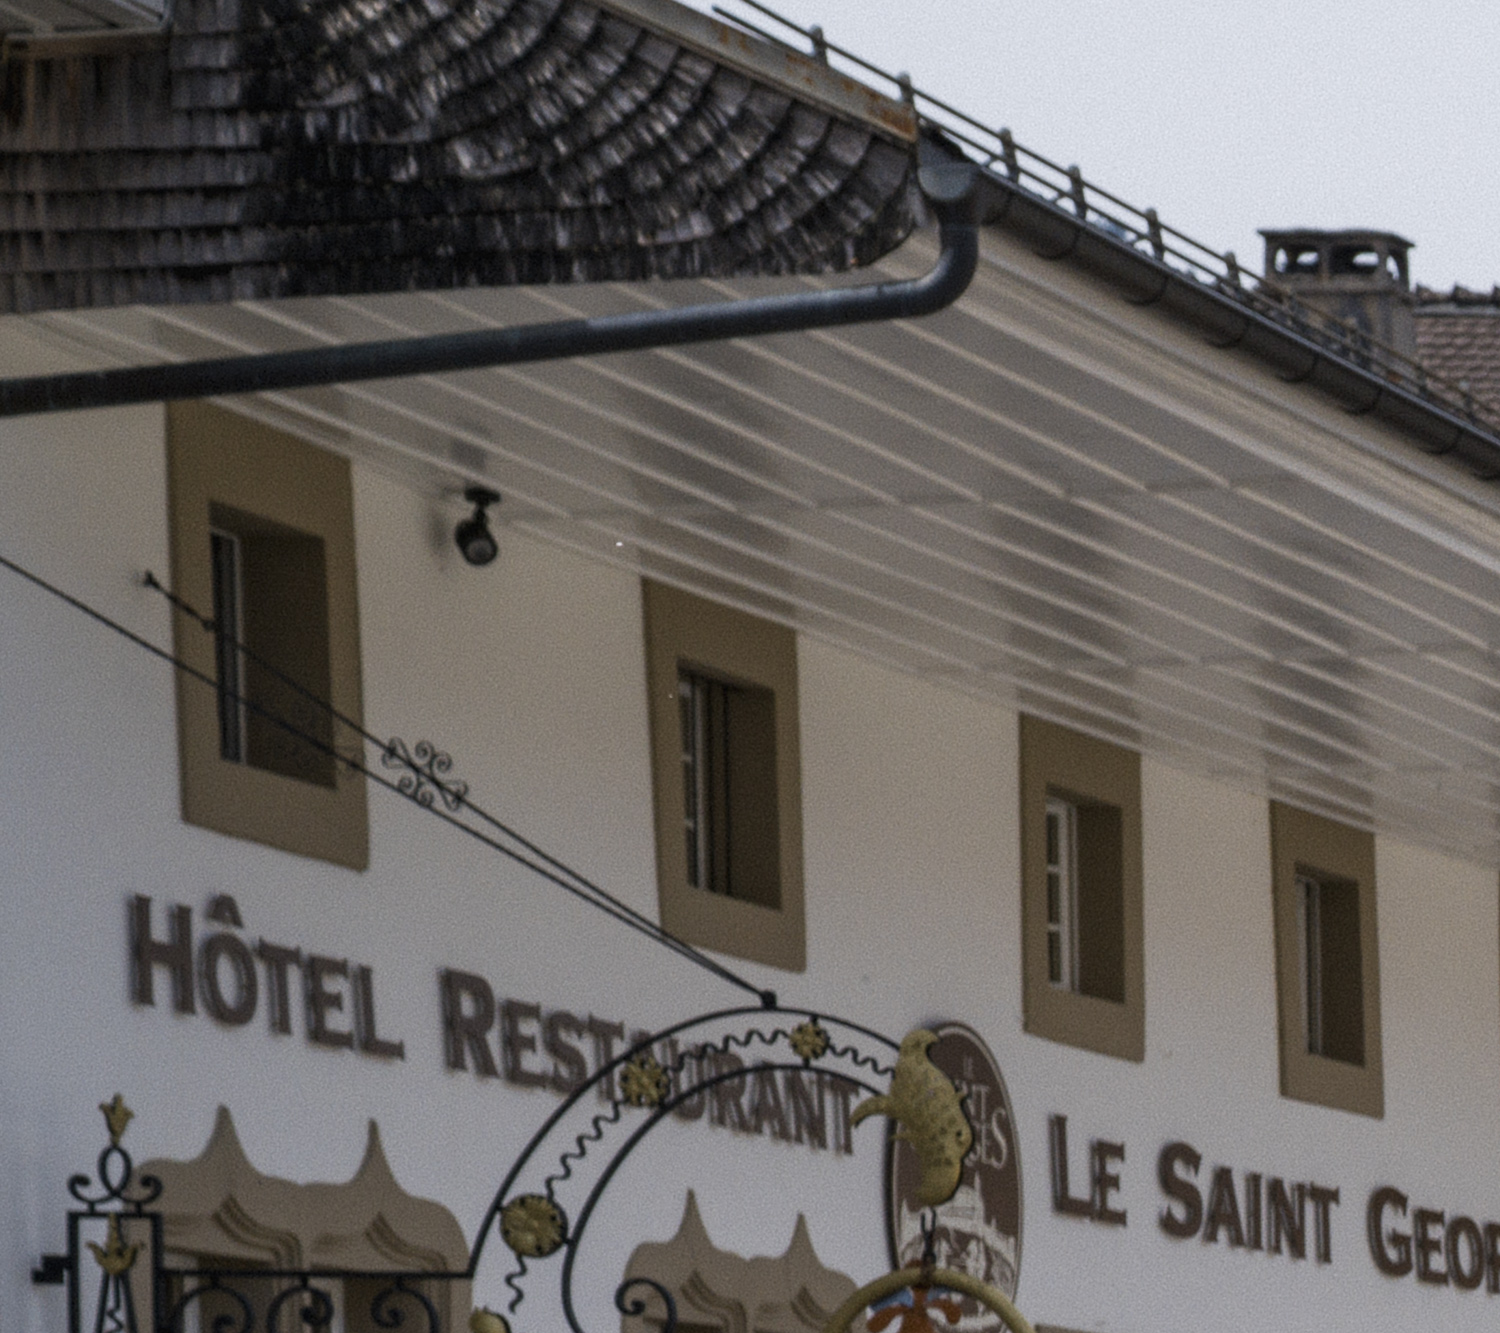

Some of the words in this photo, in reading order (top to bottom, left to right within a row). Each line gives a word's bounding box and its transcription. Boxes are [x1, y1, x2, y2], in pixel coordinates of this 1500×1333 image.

[129, 893, 404, 1061] HÔTEL
[1048, 1112, 1127, 1228] LE
[1156, 1141, 1340, 1264] SAINT
